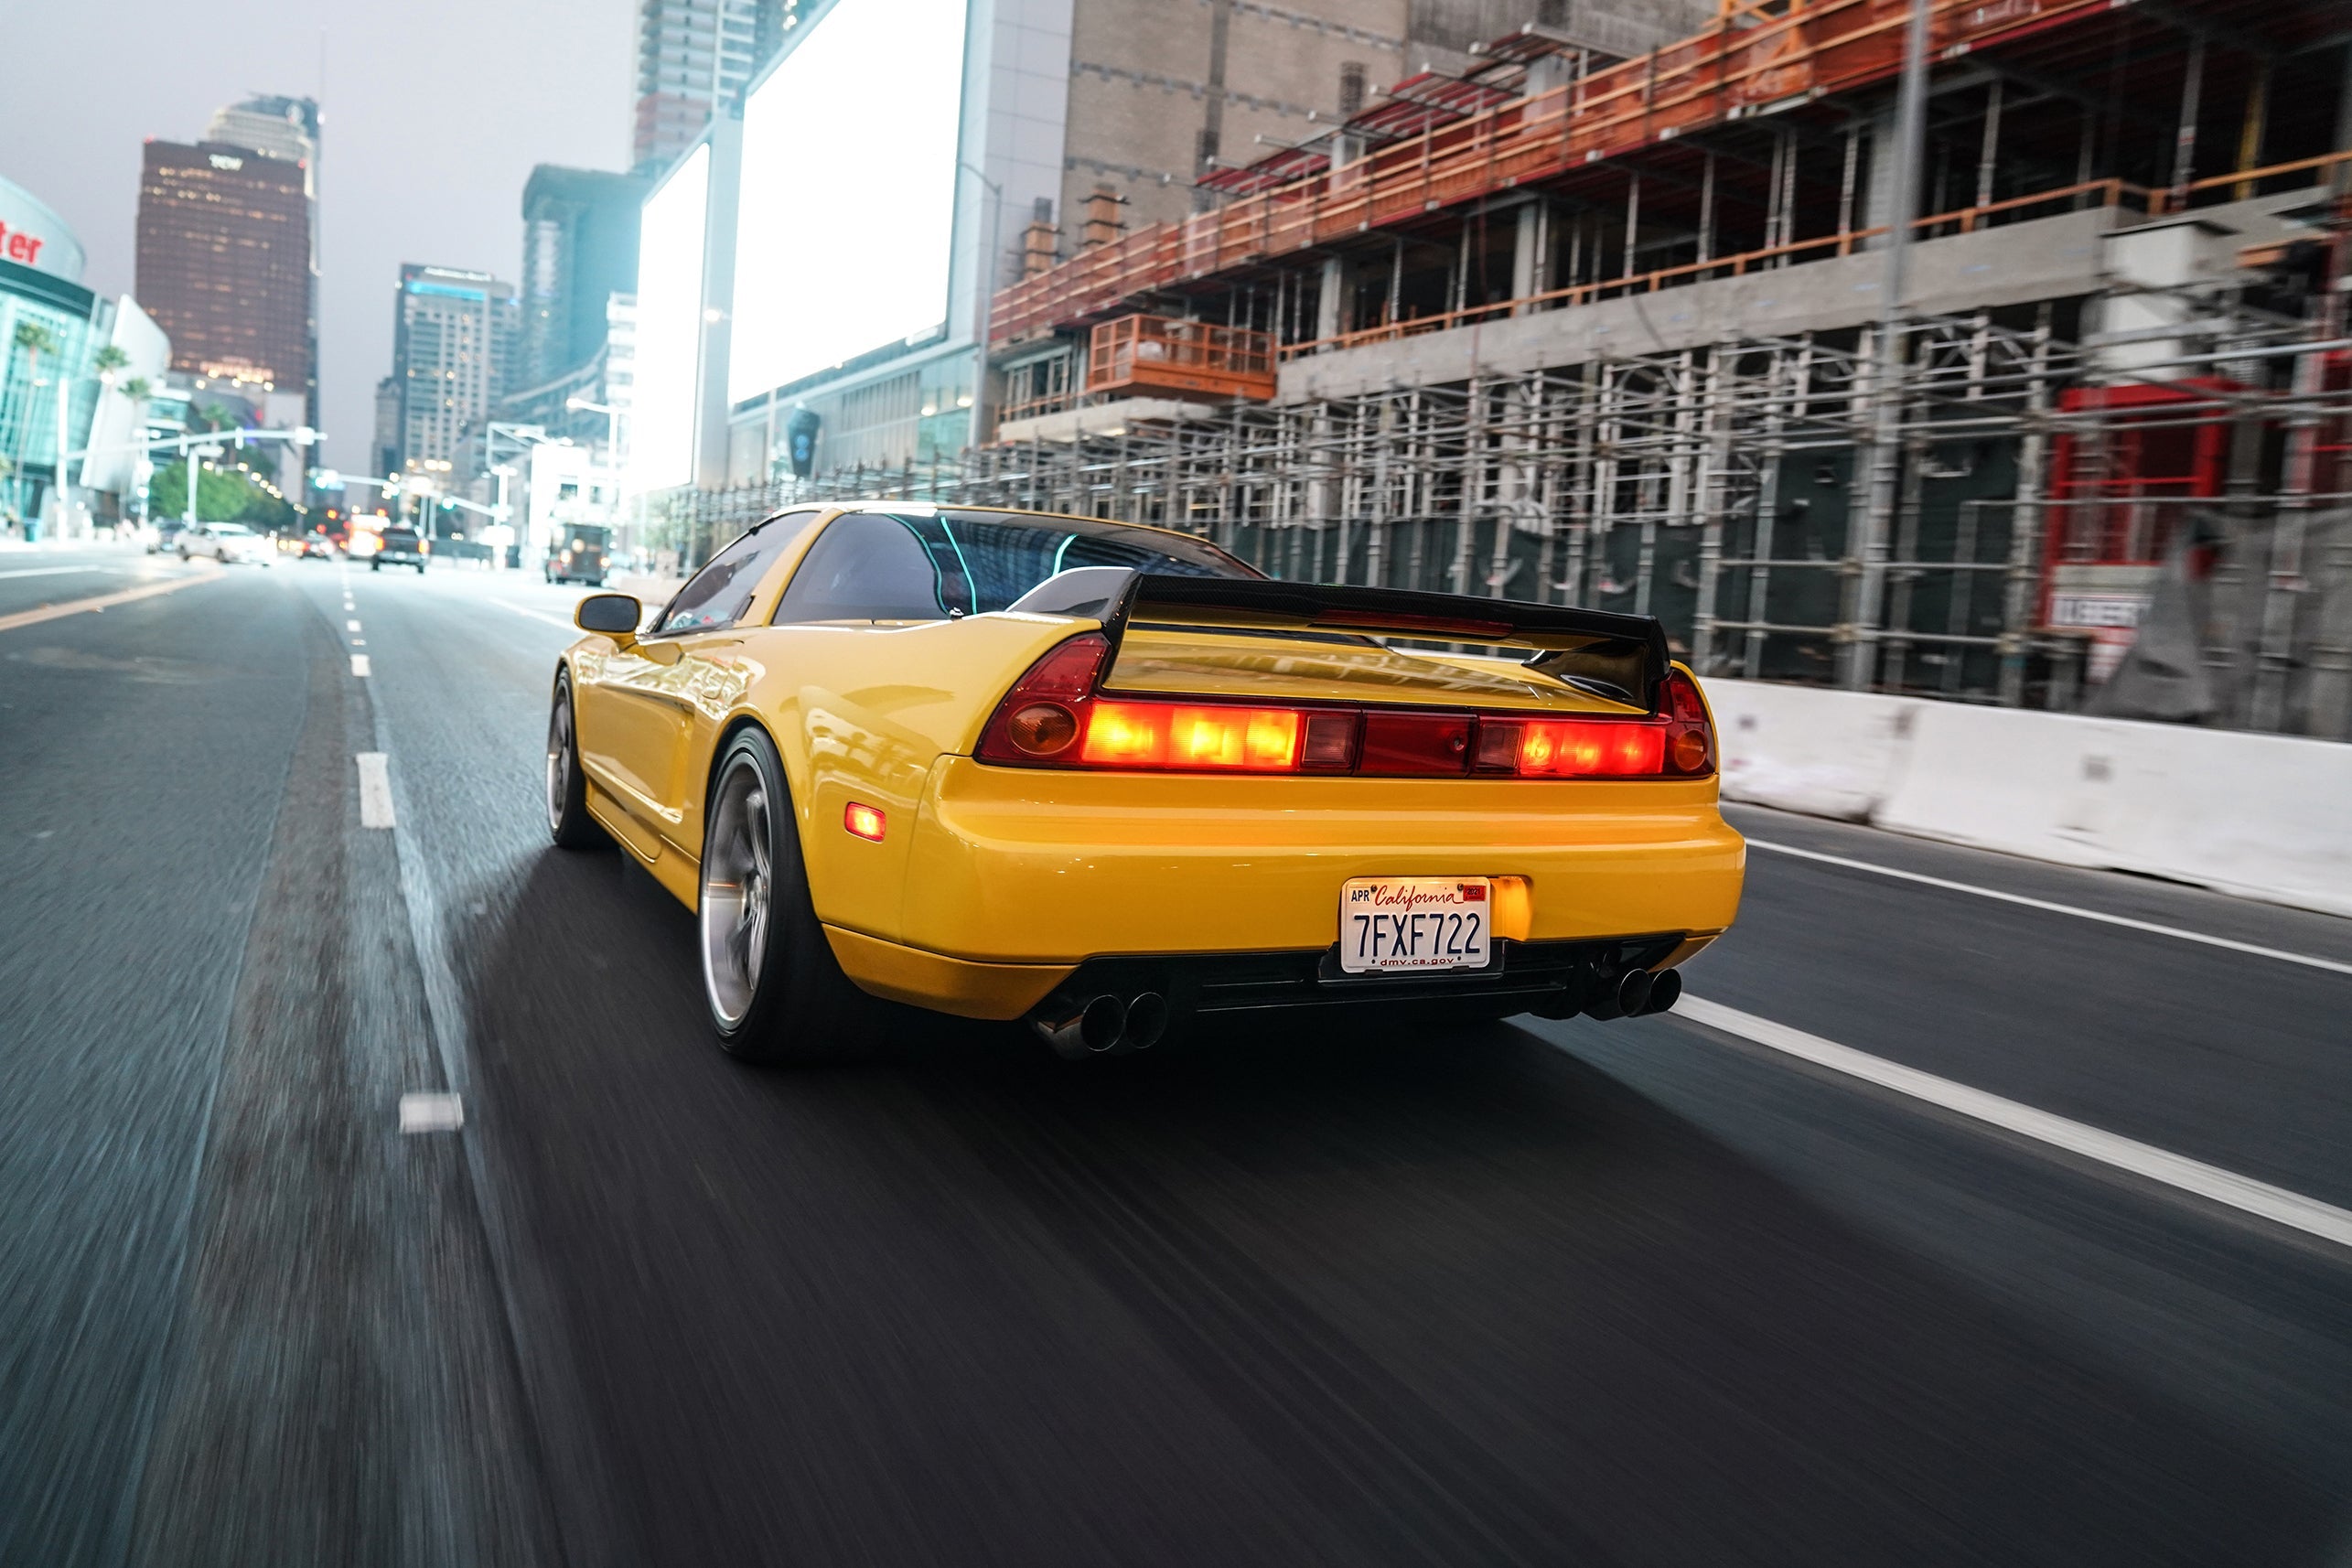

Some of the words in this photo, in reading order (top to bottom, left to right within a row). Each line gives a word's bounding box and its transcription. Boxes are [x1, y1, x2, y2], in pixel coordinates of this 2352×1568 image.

[1351, 889, 1369, 902] APR
[1374, 885, 1464, 912] California
[1354, 913, 1480, 957] 7FXF722
[1380, 957, 1454, 966] dmv.ca.gov
